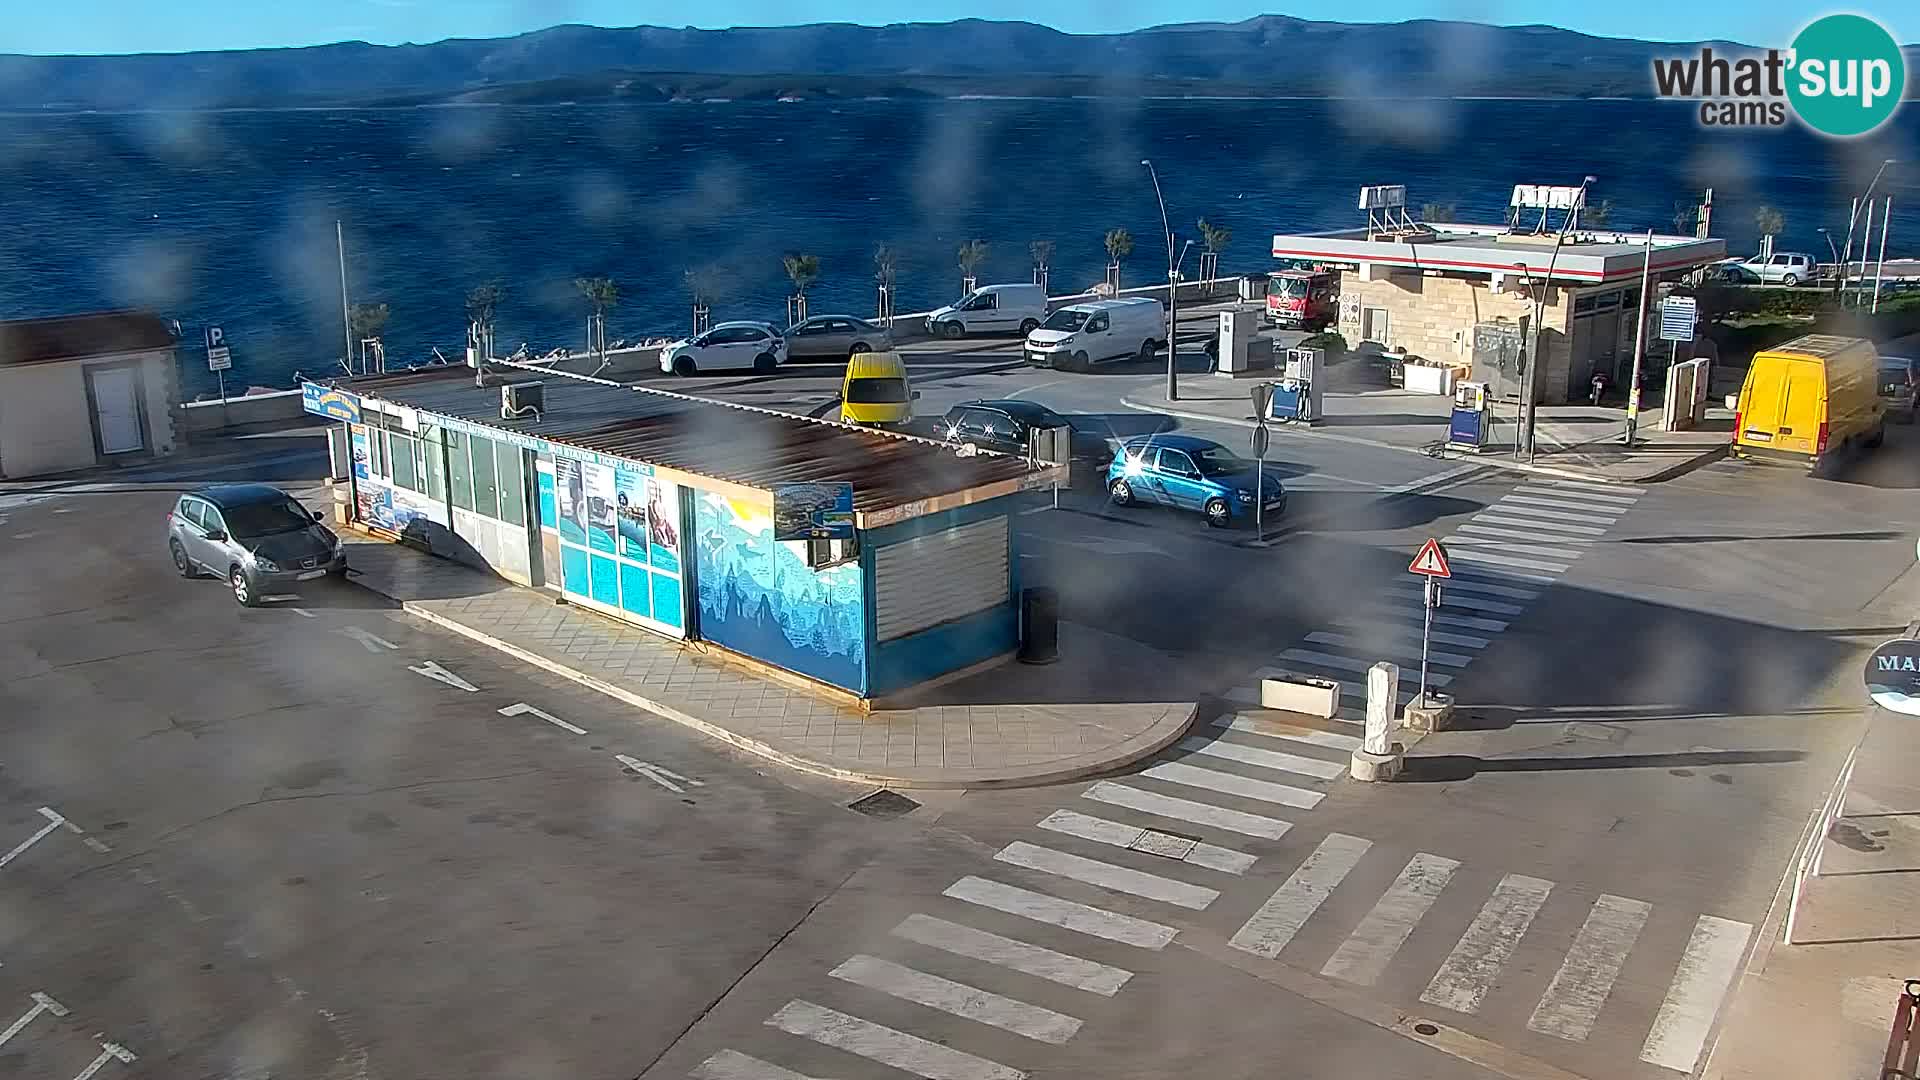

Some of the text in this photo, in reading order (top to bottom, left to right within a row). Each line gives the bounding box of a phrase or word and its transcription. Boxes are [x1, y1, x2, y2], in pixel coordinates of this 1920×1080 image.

[211, 327, 223, 346] P
[598, 454, 623, 470] TICKET
[624, 460, 651, 476] OFFICE
